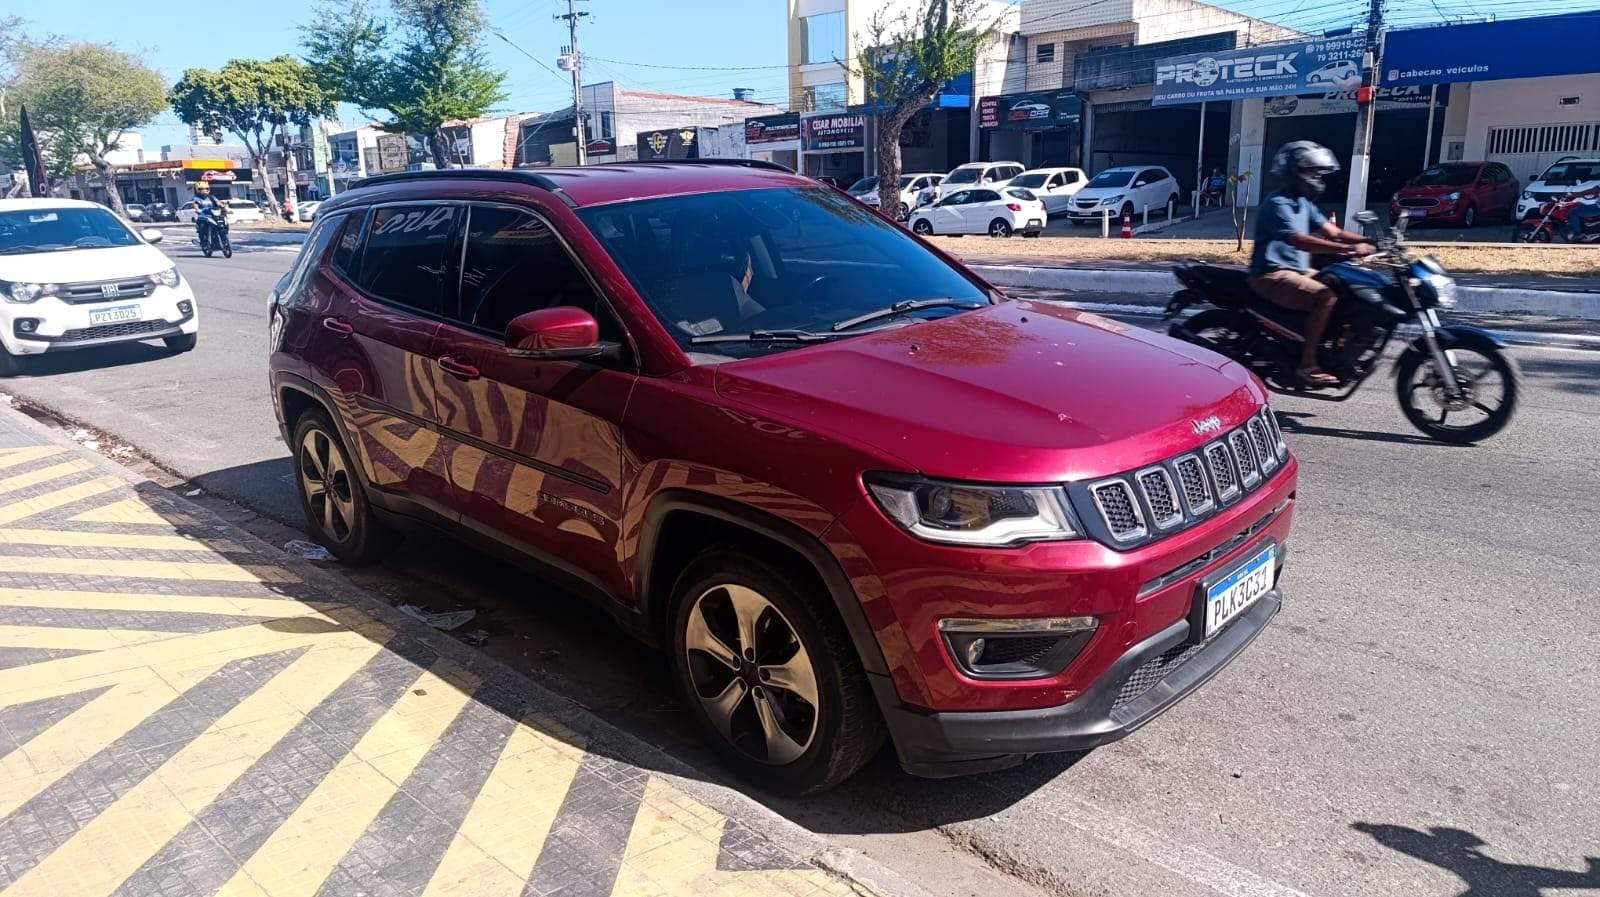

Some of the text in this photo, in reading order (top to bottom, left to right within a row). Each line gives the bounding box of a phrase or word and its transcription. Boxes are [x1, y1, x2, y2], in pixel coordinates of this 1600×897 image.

[1326, 38, 1367, 50] 99918-02
[1328, 50, 1364, 60] 3211-26
[1156, 52, 1299, 86] PROTECK
[1226, 87, 1245, 95] PALMA
[101, 283, 120, 298] FIAT
[1214, 566, 1267, 626] PLK3C31
